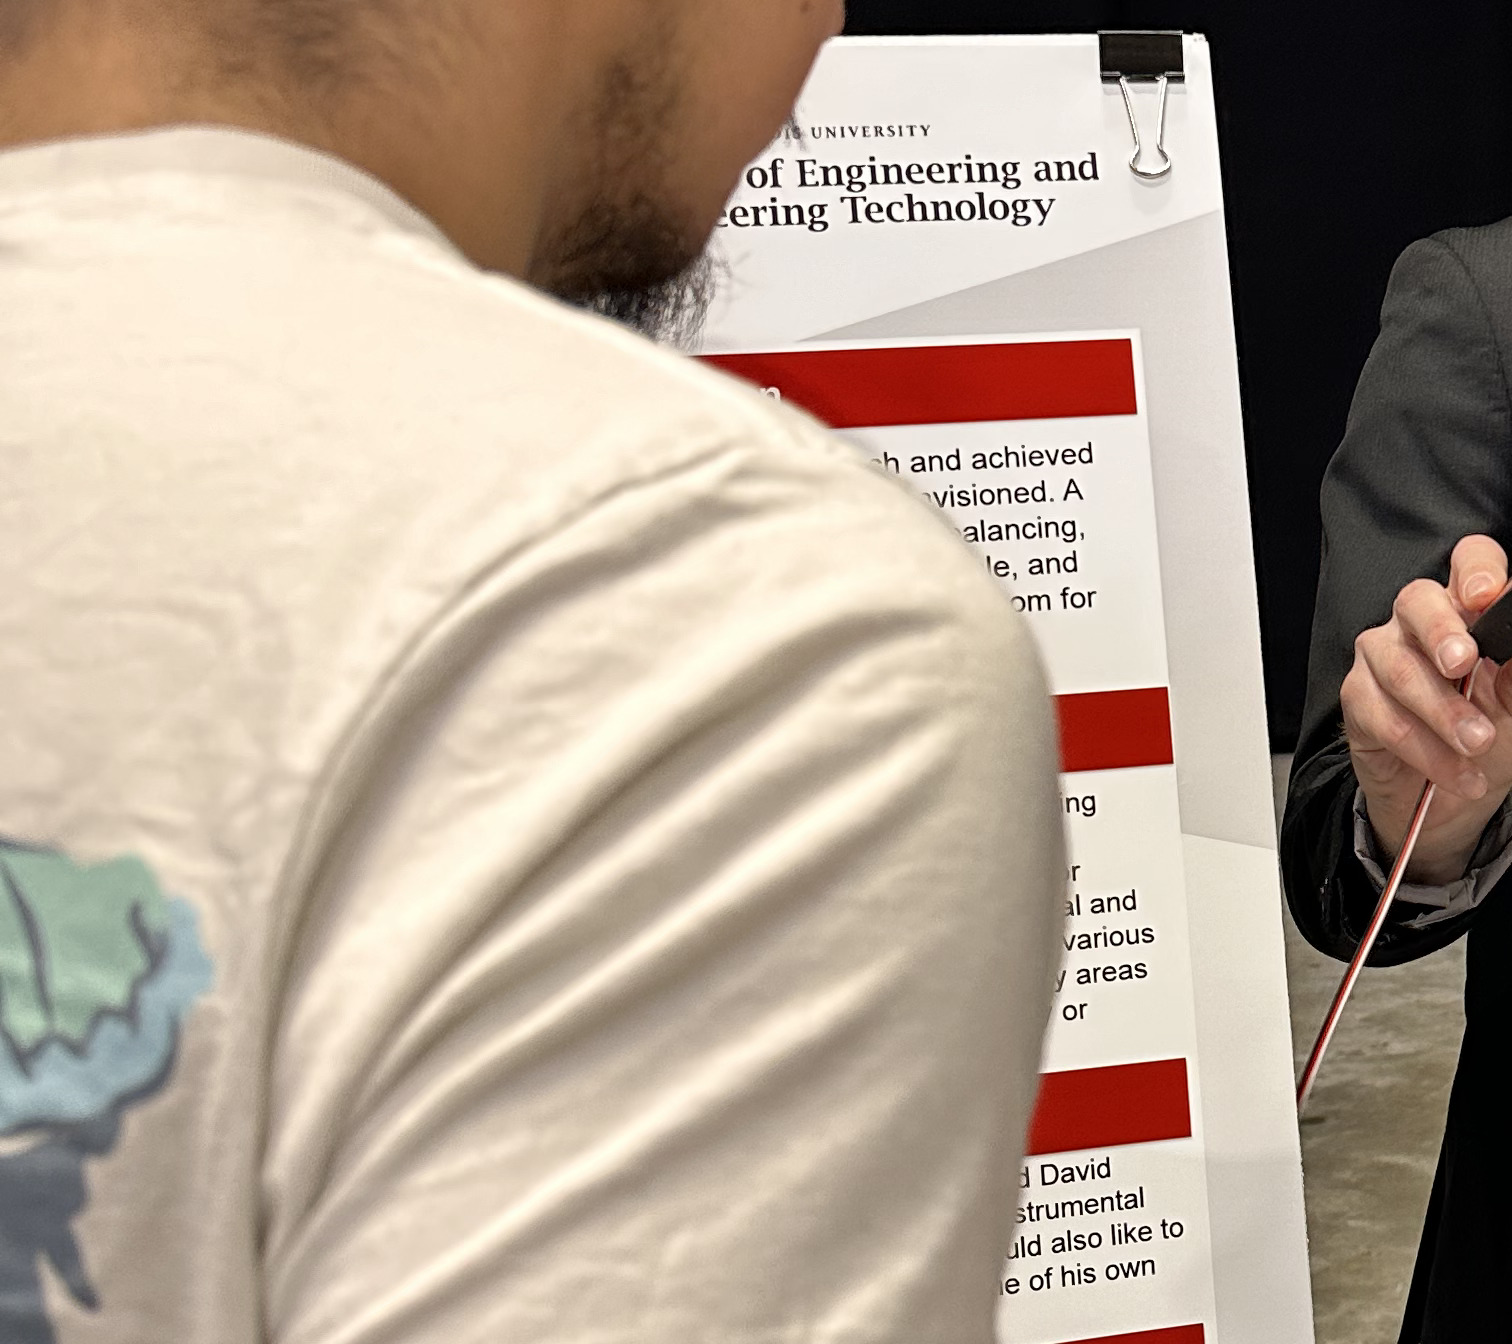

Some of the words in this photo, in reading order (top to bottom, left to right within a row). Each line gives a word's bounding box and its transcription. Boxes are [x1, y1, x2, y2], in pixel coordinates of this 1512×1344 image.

[811, 125, 930, 139] UNIVERSITY
[742, 157, 784, 188] of
[796, 154, 1021, 193] Engineering
[1034, 152, 1099, 182] and
[840, 191, 1056, 226] Technology
[910, 448, 960, 472] and
[972, 441, 1093, 469] achieved
[1063, 478, 1083, 501] A
[1028, 550, 1077, 575] and
[1060, 586, 1097, 609] for
[1090, 888, 1136, 914] and
[1060, 925, 1154, 951] various
[1076, 962, 1147, 984] areas
[1062, 1003, 1088, 1020] or
[1040, 1156, 1110, 1186] David
[1051, 1229, 1102, 1253] also
[1111, 1222, 1152, 1245] like
[1160, 1219, 1183, 1239] to
[1029, 1266, 1053, 1291] of
[1060, 1262, 1096, 1287] his
[1105, 1259, 1155, 1280] own
